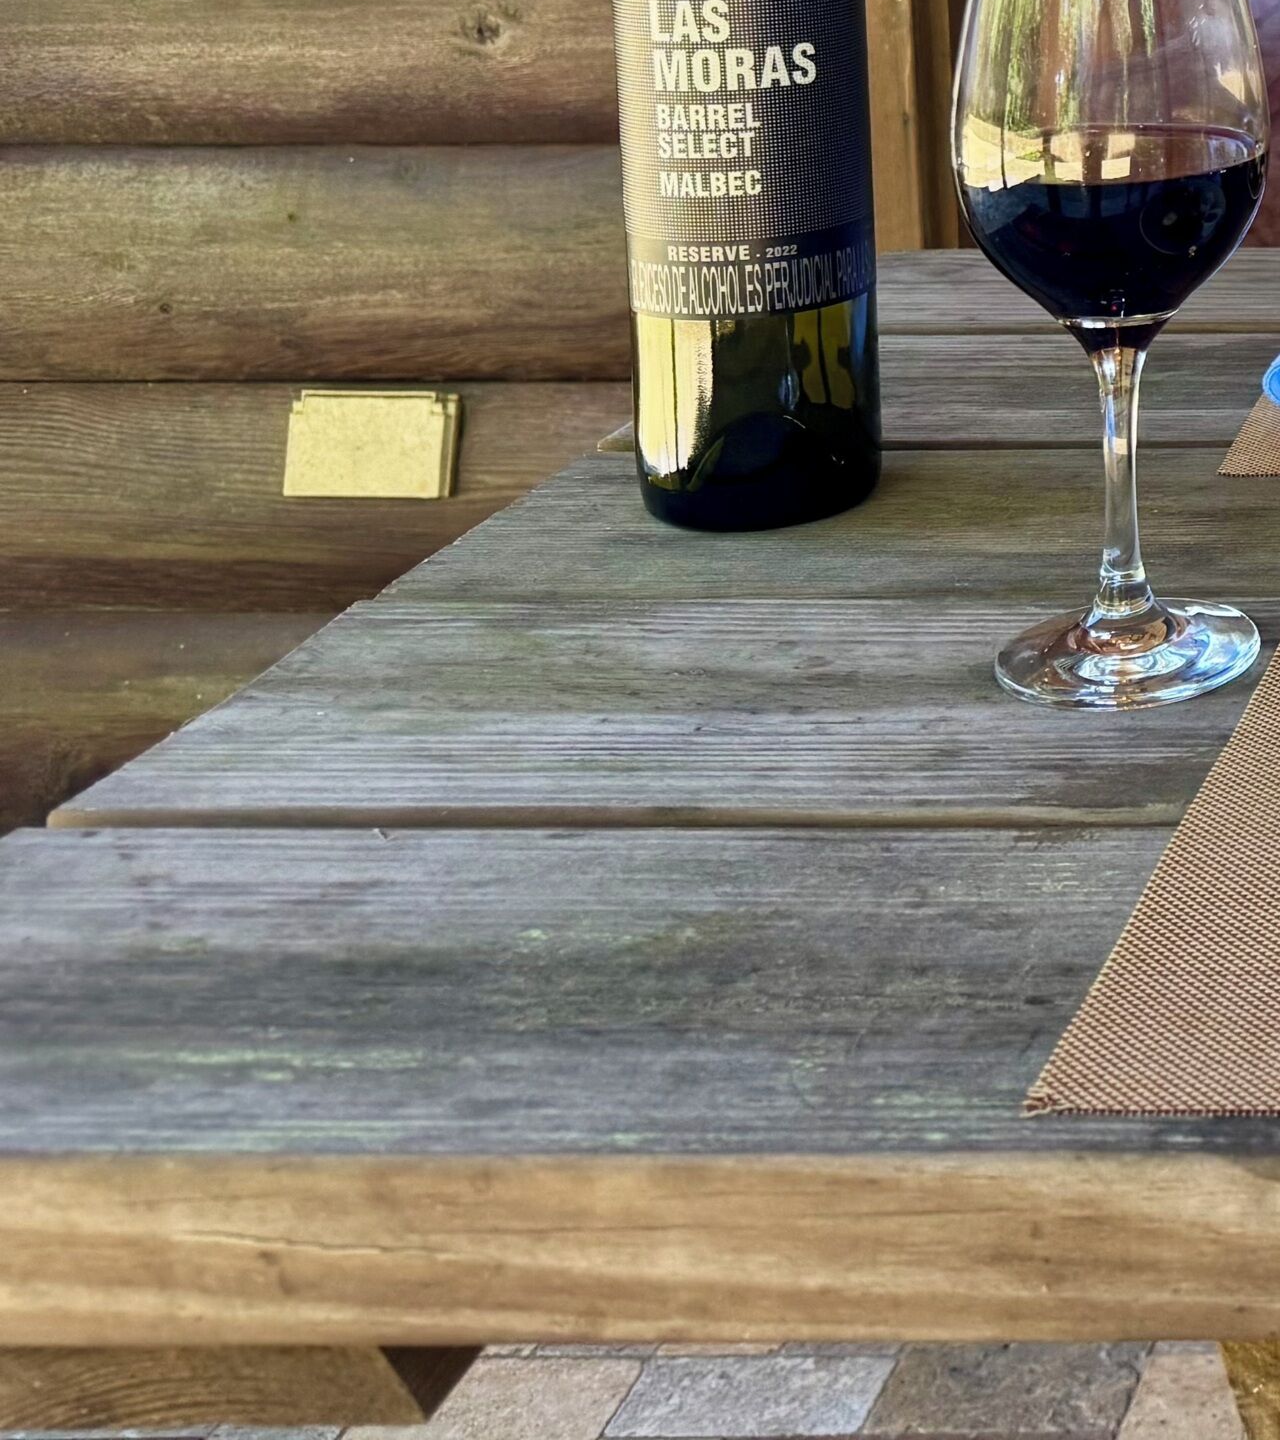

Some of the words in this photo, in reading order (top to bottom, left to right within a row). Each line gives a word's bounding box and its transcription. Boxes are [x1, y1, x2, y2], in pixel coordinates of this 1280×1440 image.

[650, 0, 730, 44] LAS
[654, 43, 817, 93] MORAS
[656, 103, 761, 131] BARREL
[659, 131, 755, 160] SELECT
[660, 170, 762, 198] MALBEC
[667, 245, 750, 261] RESERVE
[765, 244, 798, 258] 2022
[639, 261, 671, 313] EXCESO
[672, 265, 688, 314] DE
[689, 265, 745, 315] ALCOHOL
[745, 263, 763, 313] ES
[764, 254, 836, 312] PERJUDICIAL
